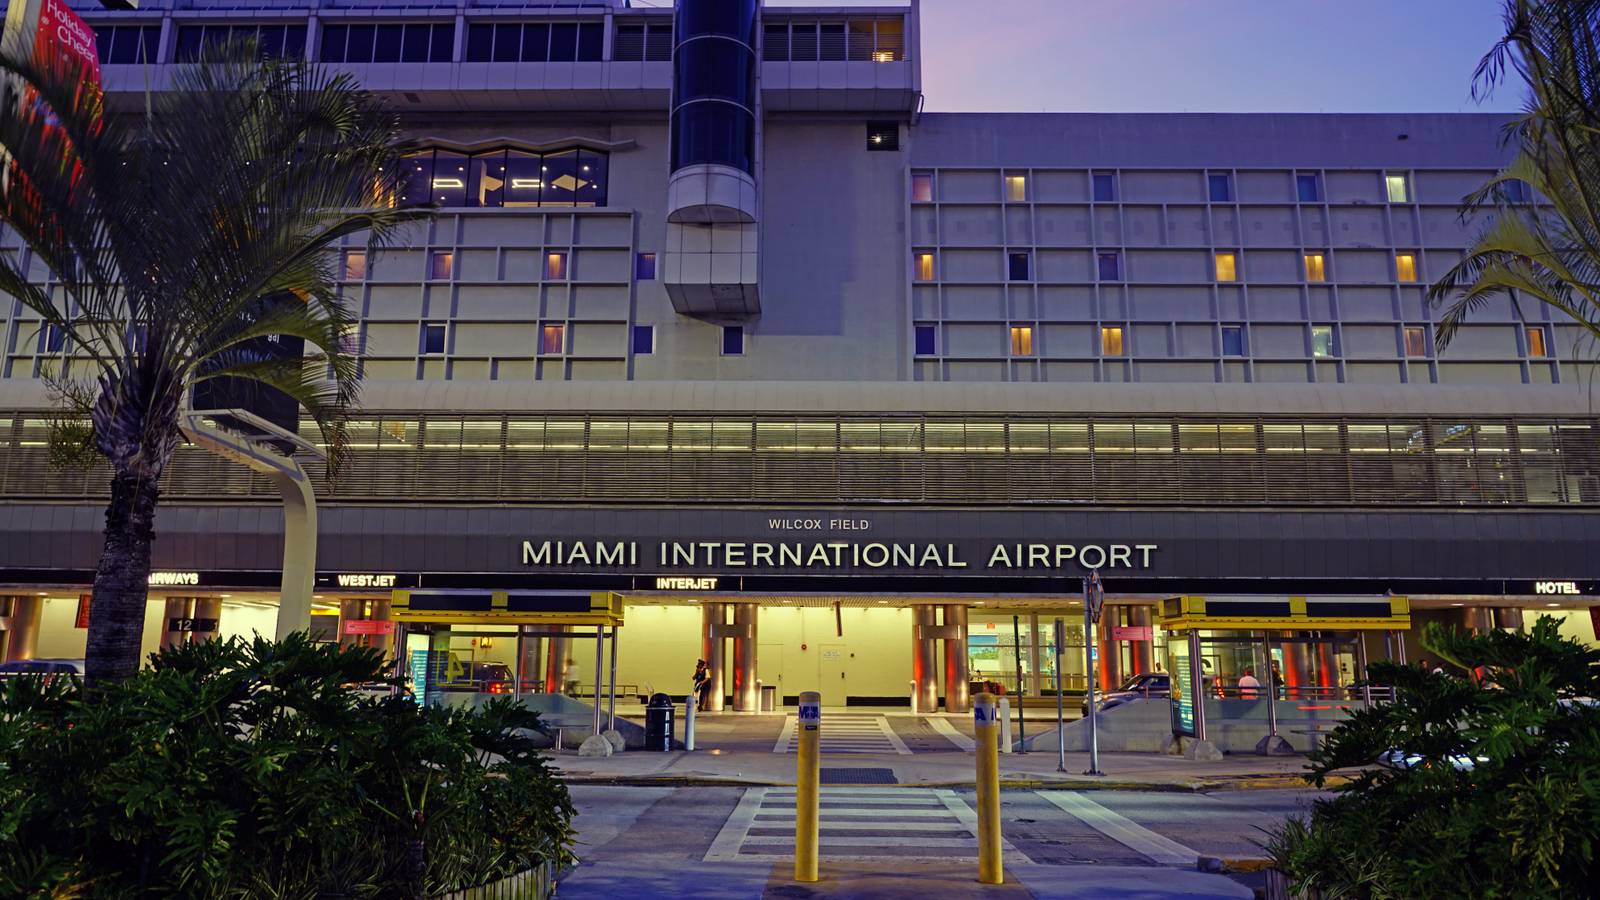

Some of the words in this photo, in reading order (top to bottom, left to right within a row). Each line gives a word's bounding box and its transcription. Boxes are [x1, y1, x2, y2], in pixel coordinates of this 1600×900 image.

[47, 0, 92, 48] Holiday
[57, 26, 95, 63] Cheer
[768, 518, 822, 531] WILCOX
[830, 518, 870, 531] FIELD
[522, 540, 638, 566] MIAMI
[660, 541, 968, 568] INTERNATIONAL
[987, 543, 1158, 570] AIRPORT
[337, 574, 397, 588] WESTJET
[656, 576, 719, 591] INTERJET
[1535, 581, 1581, 595] HOTEL
[177, 620, 192, 631] 12
